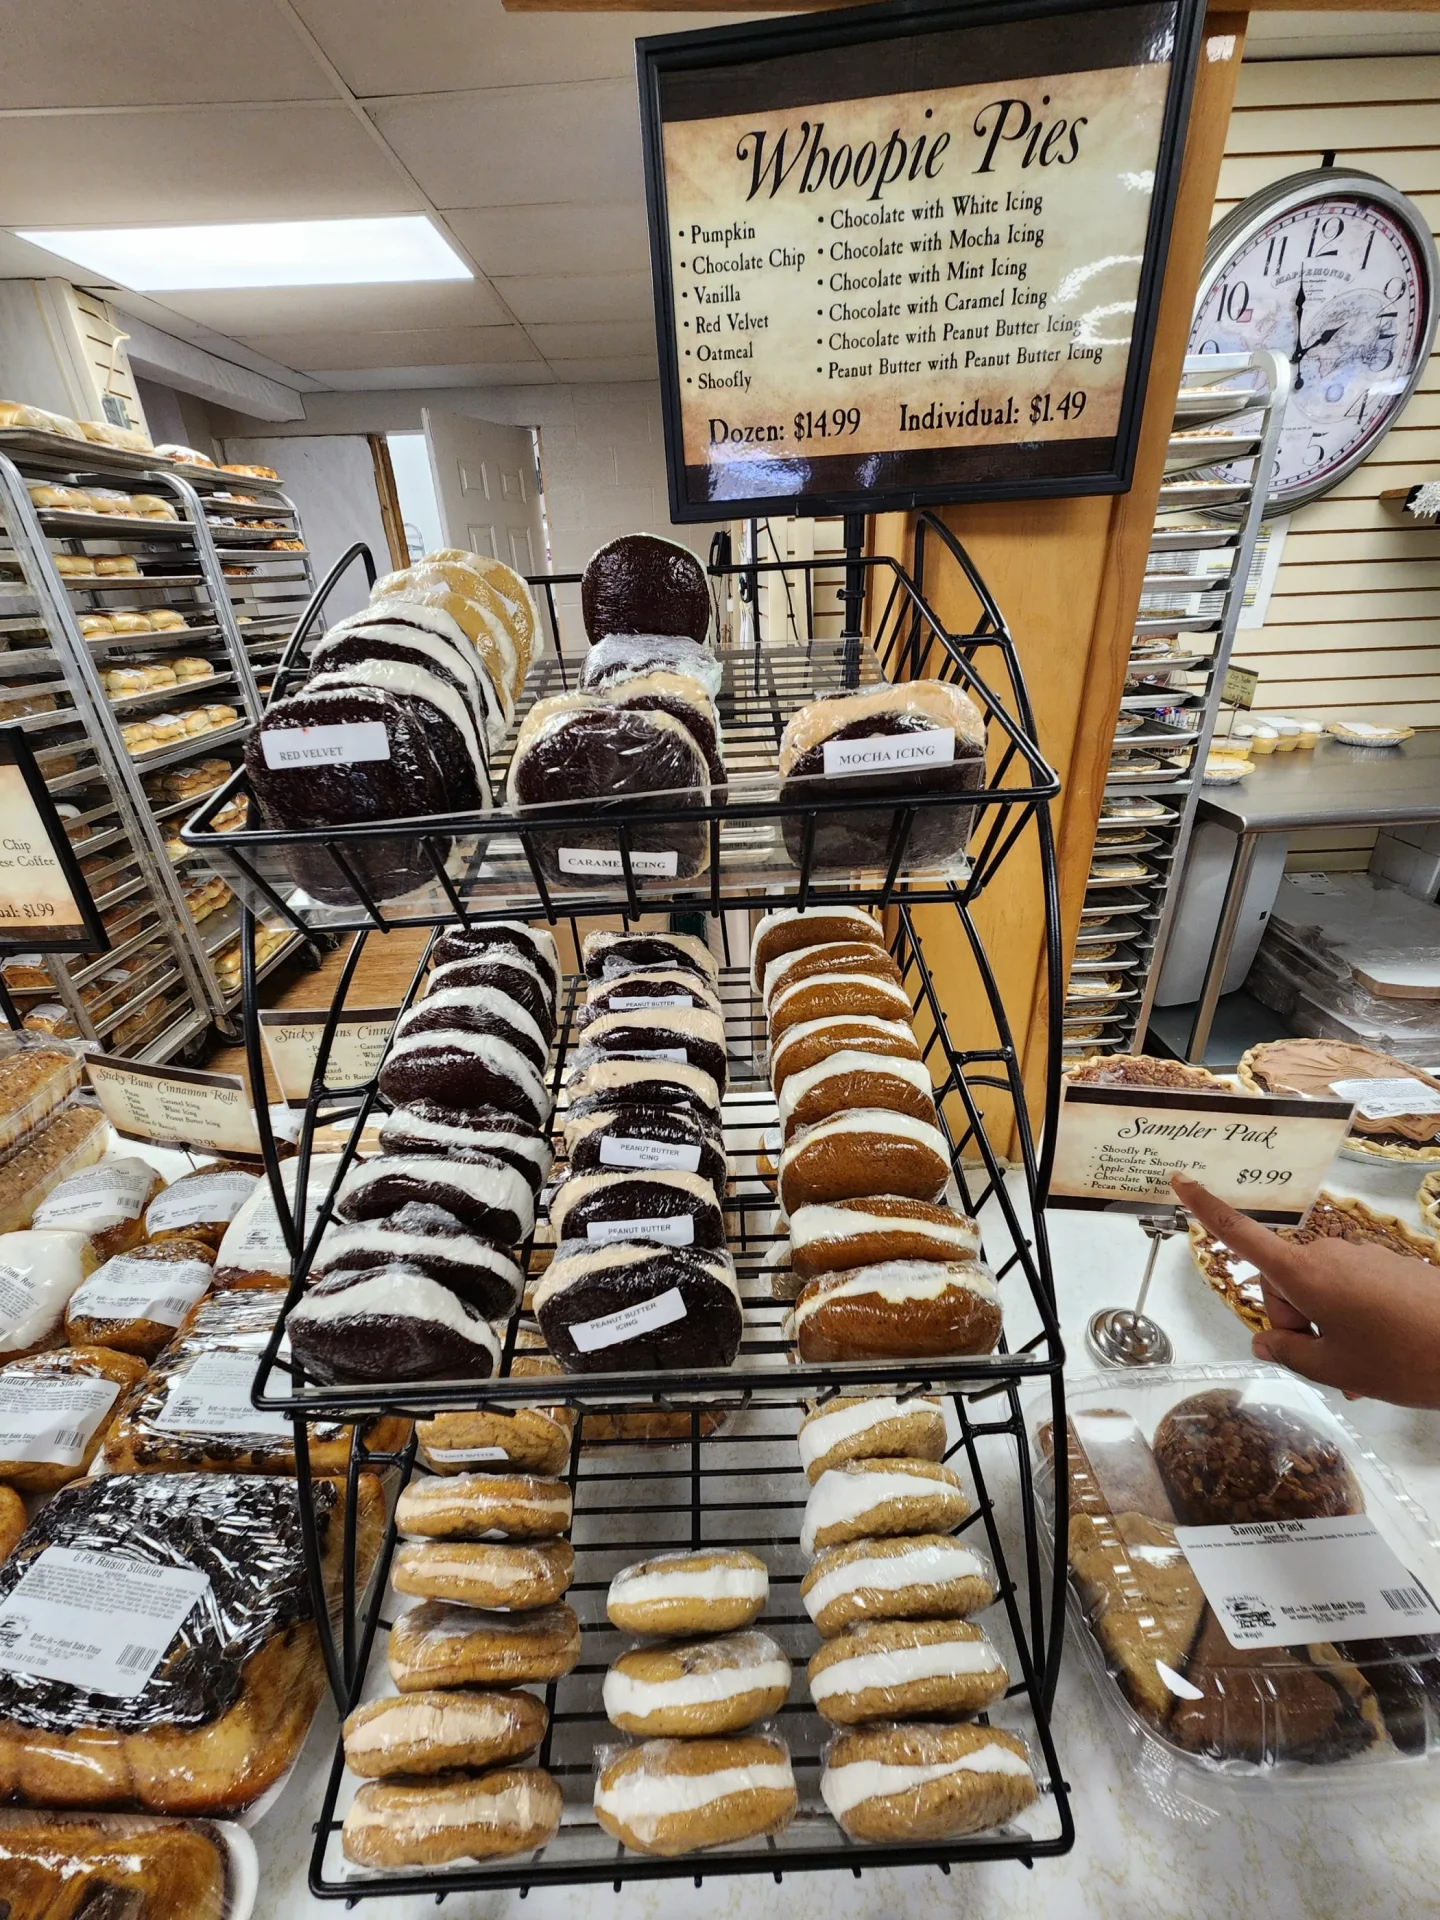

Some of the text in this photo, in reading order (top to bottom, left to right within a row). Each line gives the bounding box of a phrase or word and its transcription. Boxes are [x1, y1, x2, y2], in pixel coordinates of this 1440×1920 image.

[736, 95, 1088, 202] Whoopie Pies
[830, 190, 1043, 229] Chocolate with White Icing
[690, 221, 756, 248] Pumpkin
[830, 223, 1044, 261] Chocolate with Mocha Icing
[1305, 216, 1345, 258] 12
[1263, 236, 1289, 277] 11
[1360, 229, 1376, 270] 1
[692, 248, 806, 275] Chocolate Chip
[829, 257, 1027, 292] Chocolate with Mint Icing
[694, 284, 741, 305] Vanilla
[829, 286, 1047, 322] Chocolate with Caramel Icing
[1216, 281, 1250, 322] 10
[1376, 276, 1407, 318] 2
[696, 312, 769, 334] Red Velvet
[828, 314, 1081, 350] Chocolate with Peanut Butter Icing
[697, 341, 754, 361] Oatmeal
[828, 342, 1104, 380] Peanut Butter with Peanut Butter Icing
[698, 370, 752, 393] Shoofly
[898, 391, 1087, 432] Individual: $1.49
[1344, 388, 1369, 425] 4
[708, 407, 861, 445] Dozen: $14.99
[1302, 432, 1329, 467] 5
[279, 746, 344, 761] RED VELVET
[839, 745, 935, 766] MOCHA ICING
[3, 837, 32, 854] Chip
[17, 855, 56, 868] Coffee
[568, 858, 666, 869] CARAME ICING
[24, 902, 55, 919] $1.99
[275, 1027, 315, 1043] Sticky
[96, 1068, 238, 1105] Sticky Buns Cinnamon Rolls
[1117, 1116, 1278, 1149] Sampler Pack
[620, 1143, 680, 1156] PEANUT BUTTER
[639, 1153, 659, 1162] ICING
[1101, 1144, 1159, 1158] Shoofly Pie
[1096, 1163, 1165, 1176] Apple Streusel
[1099, 1153, 1207, 1171] Chocolate Shoofly Pie
[1091, 1181, 1170, 1195] Pecan Sticky bun
[1094, 1172, 1140, 1184] Chocolate
[1236, 1168, 1293, 1186] $9.99
[608, 1224, 671, 1235] PEANUT BUTTER
[20, 1277, 36, 1290] Roll
[590, 1302, 657, 1331] PEANUT BUTTER
[615, 1318, 638, 1332] ICING
[31, 1380, 58, 1388] Pecan
[60, 1379, 85, 1388] Sticky
[1230, 1519, 1306, 1537] Sampler Pack
[73, 1553, 165, 1578] 6 Pk Raisin Stickies
